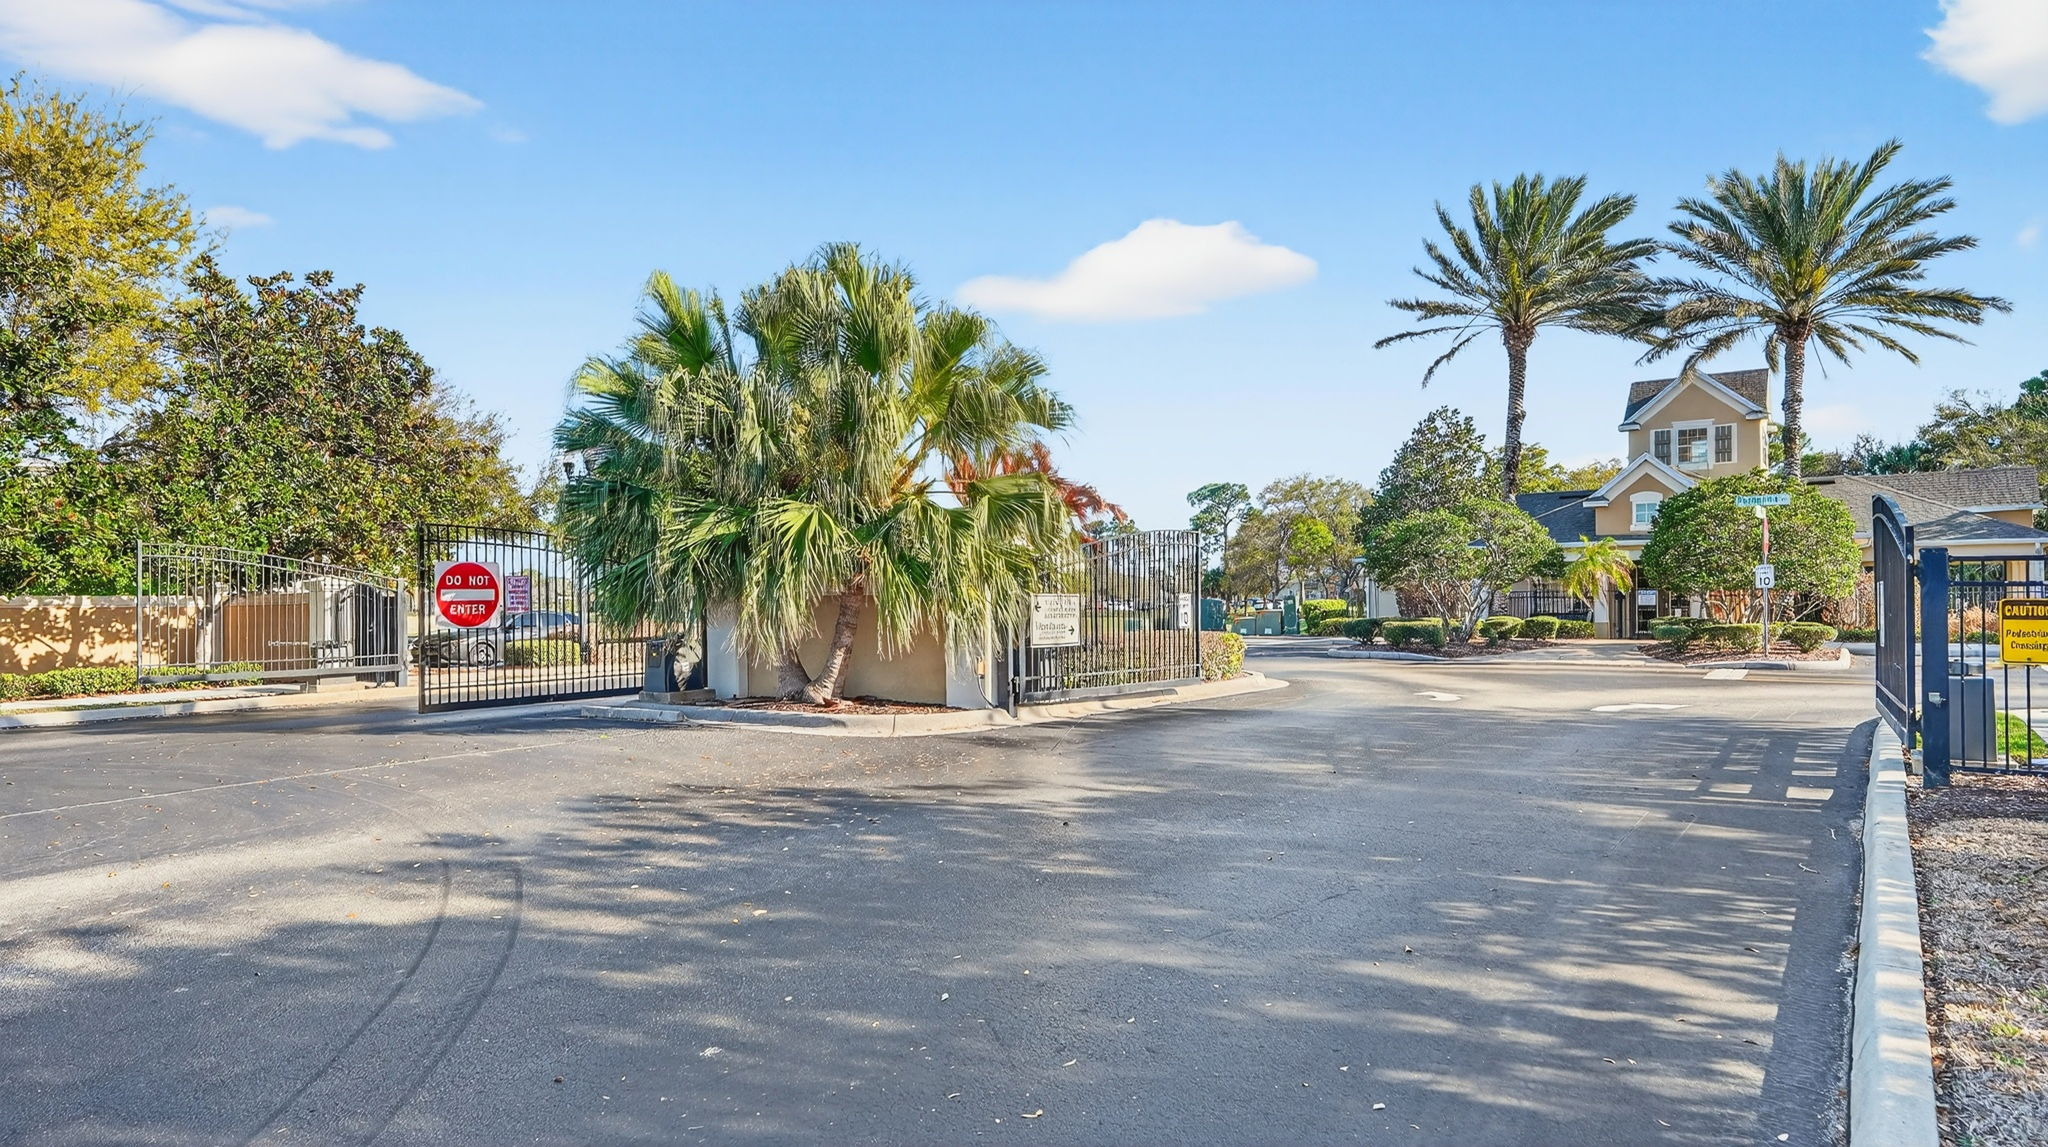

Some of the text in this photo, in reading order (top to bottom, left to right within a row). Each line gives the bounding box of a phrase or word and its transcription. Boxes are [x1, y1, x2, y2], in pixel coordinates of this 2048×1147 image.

[445, 575, 490, 586] DO NOT
[1759, 576, 1771, 586] 10
[449, 604, 486, 615] ENTER
